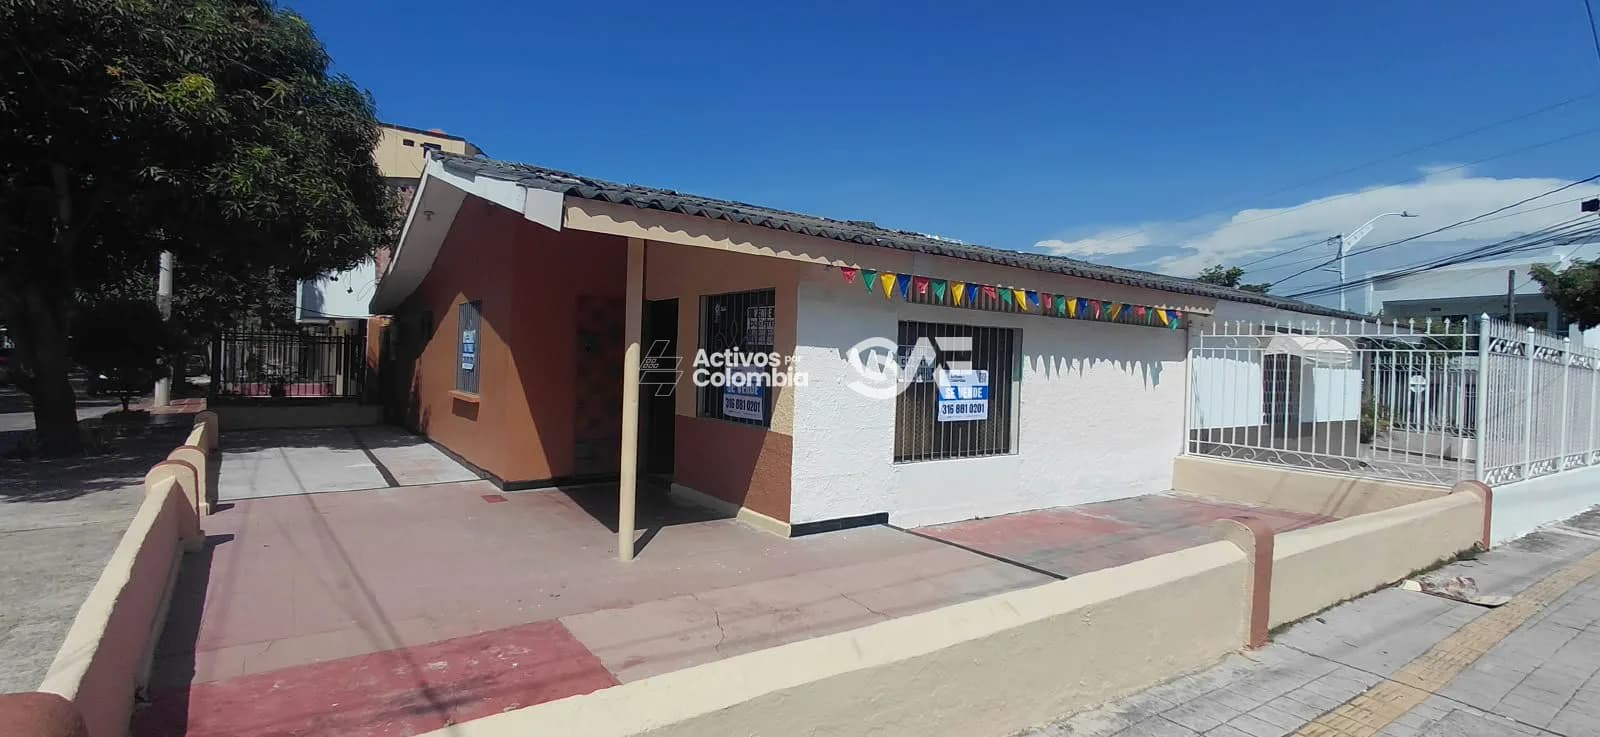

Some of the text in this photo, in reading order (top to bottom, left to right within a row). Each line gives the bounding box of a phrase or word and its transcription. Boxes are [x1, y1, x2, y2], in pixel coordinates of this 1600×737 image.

[959, 387, 983, 399] VENDE
[725, 397, 735, 409] 316
[747, 400, 761, 413] 0201
[942, 404, 954, 415] 316
[969, 403, 985, 414] 0201
